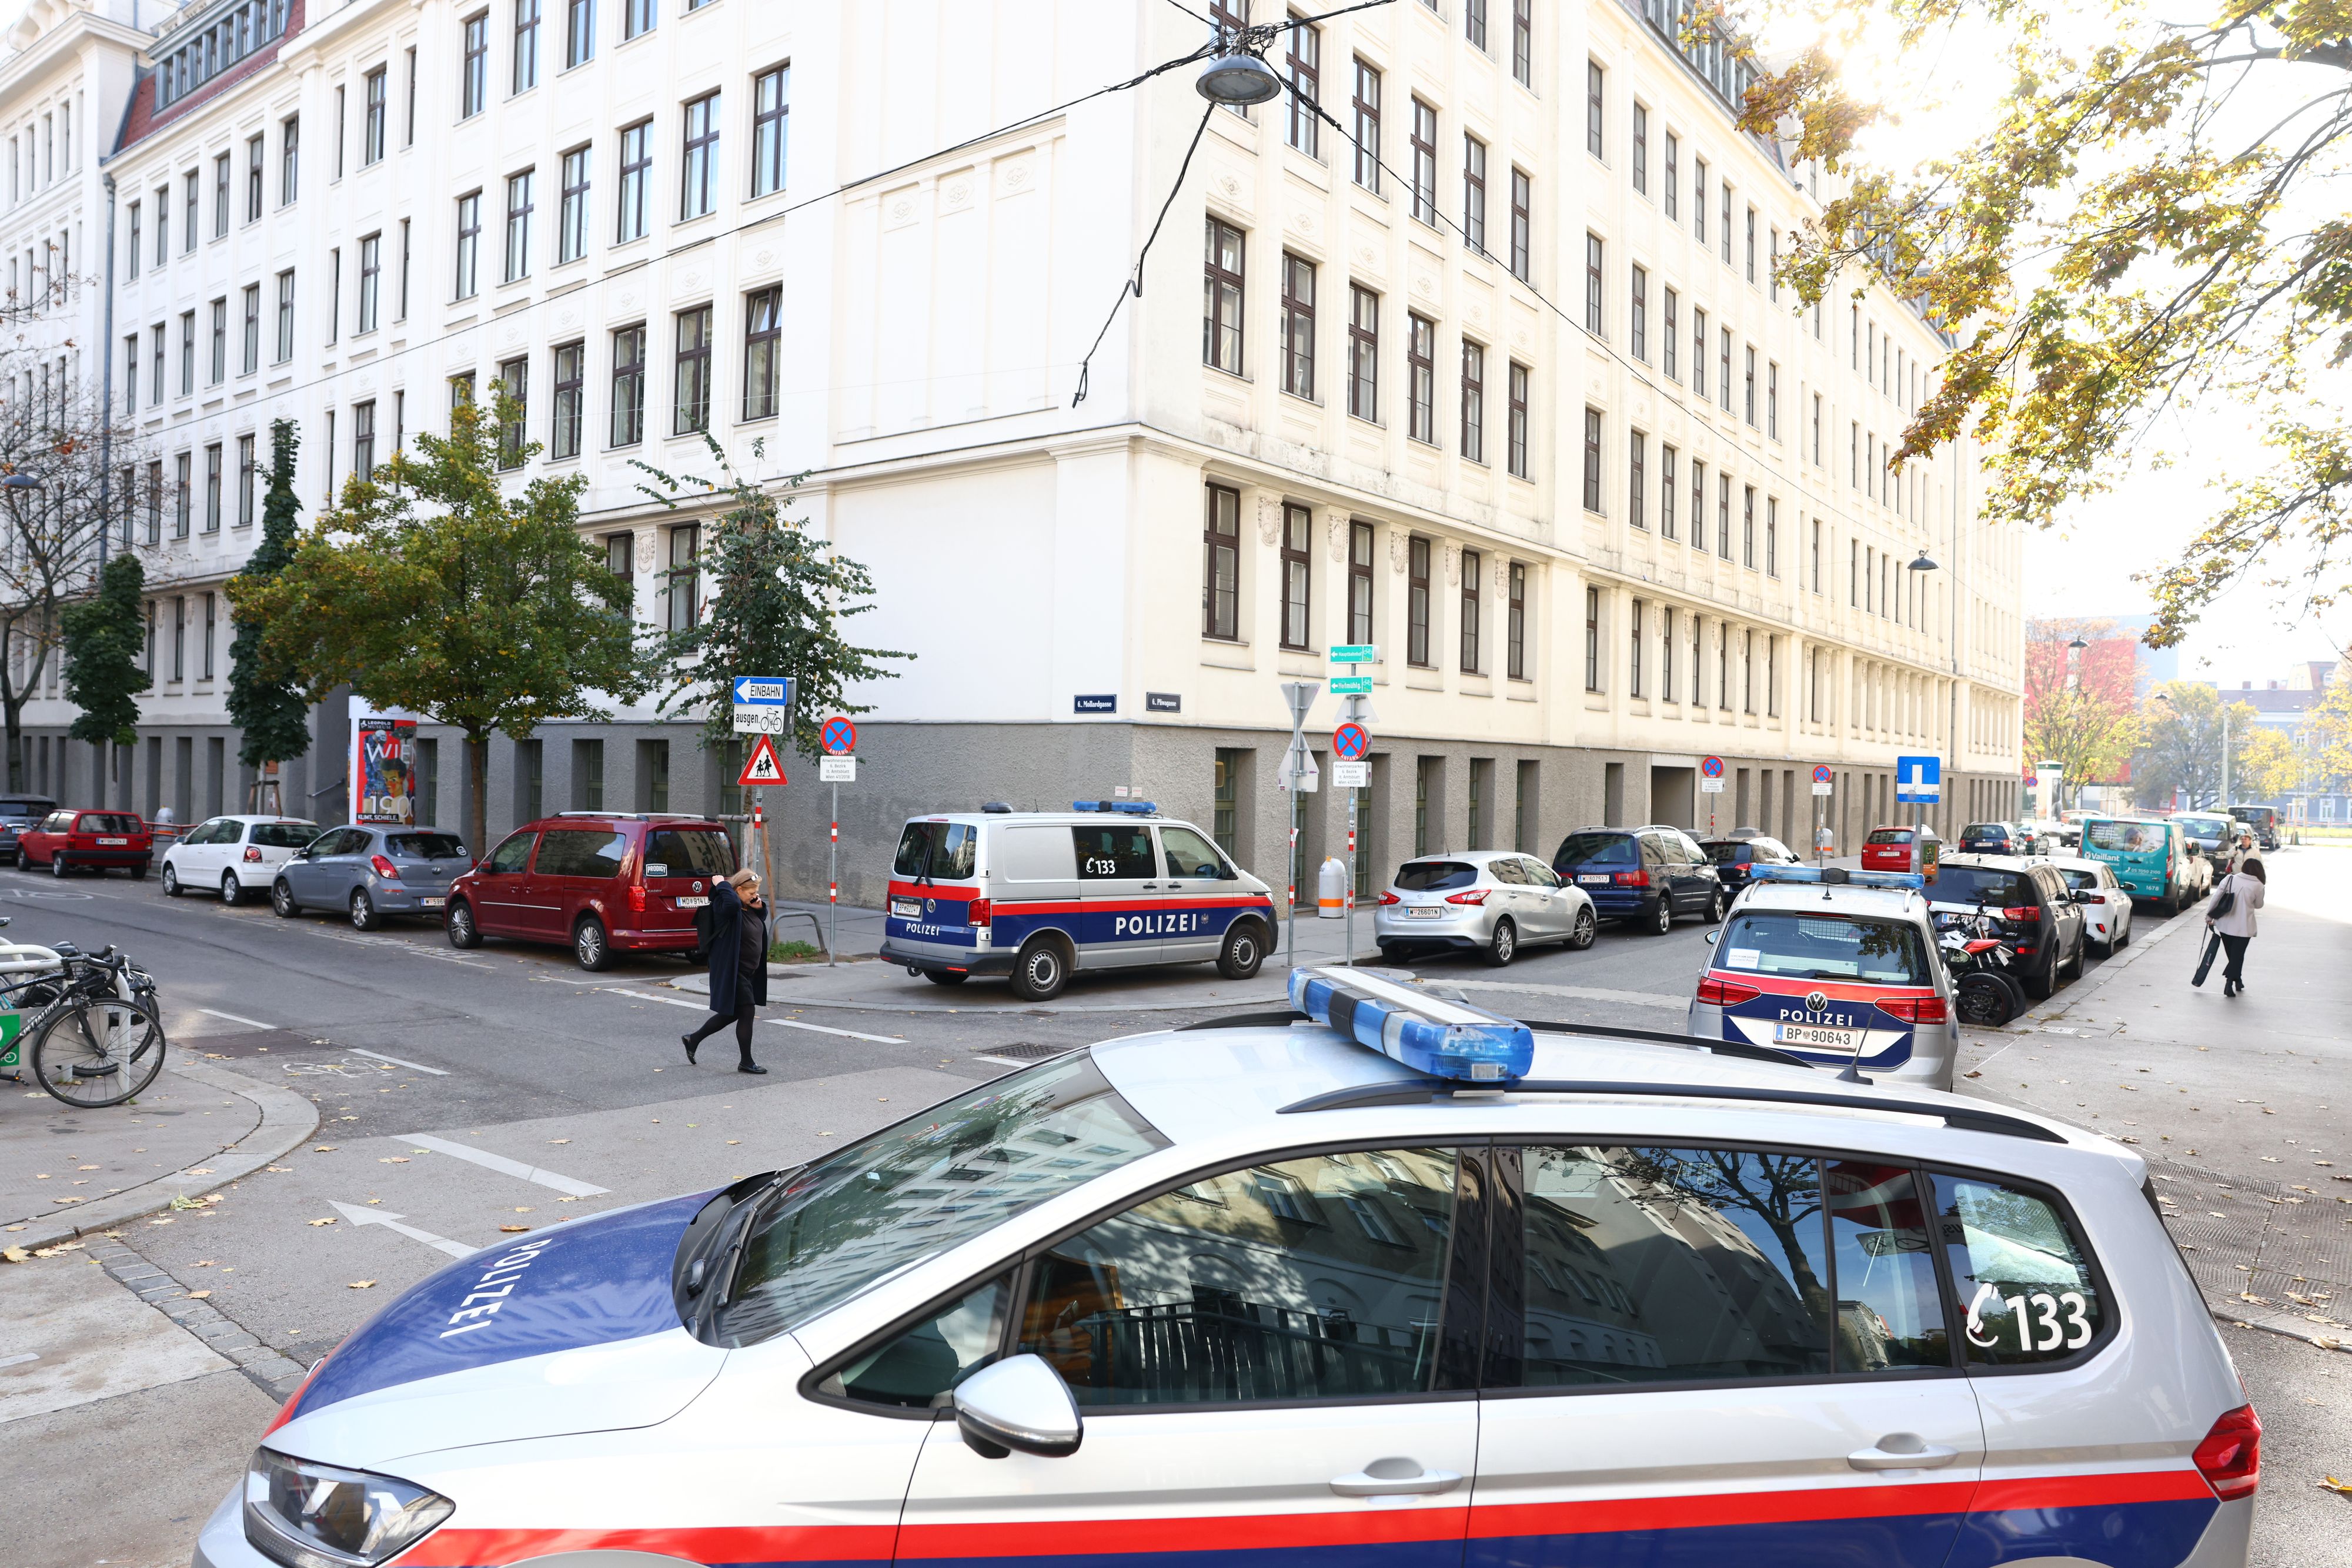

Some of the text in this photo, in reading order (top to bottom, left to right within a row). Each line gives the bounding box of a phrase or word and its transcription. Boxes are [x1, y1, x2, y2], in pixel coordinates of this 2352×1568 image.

[750, 686, 780, 697] EINBAHN
[1083, 700, 1112, 709] Mollardgasse
[1157, 698, 1177, 707] Pliwagasse
[736, 713, 760, 726] ausgen.
[2092, 852, 2120, 862] Vaillant
[1095, 860, 1115, 874] 133
[906, 905, 918, 913] 92041
[906, 922, 940, 936] POLIZEI
[1115, 914, 1197, 935] POLIZEI
[19, 998, 60, 1036] SPECIALIZED
[1780, 1009, 1852, 1027] POLIZEI
[1786, 1028, 1802, 1040] BP
[1812, 1030, 1850, 1045] 90643
[439, 1239, 553, 1338] POLIZEI
[2005, 1292, 2092, 1351] 133
